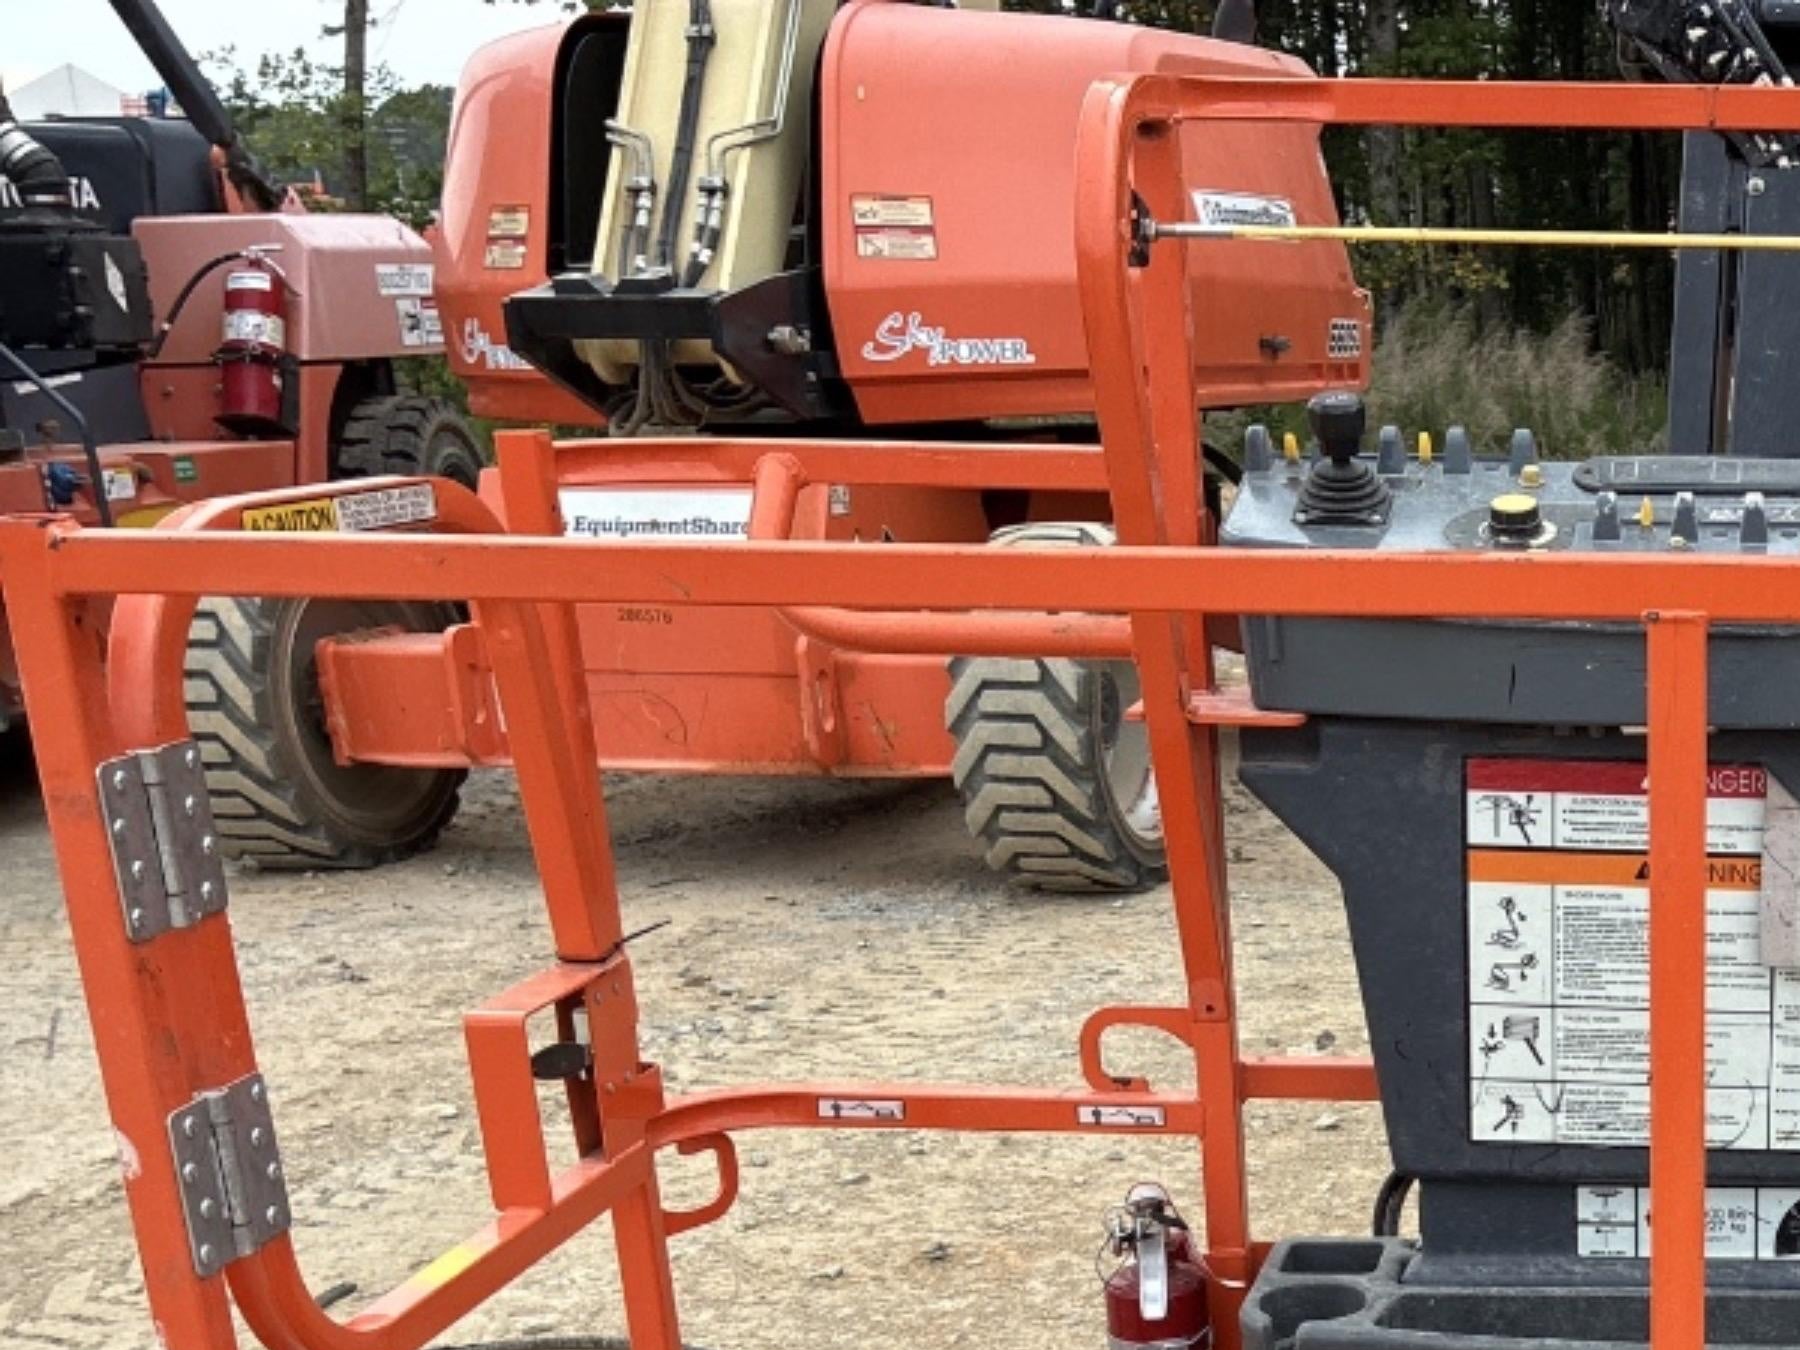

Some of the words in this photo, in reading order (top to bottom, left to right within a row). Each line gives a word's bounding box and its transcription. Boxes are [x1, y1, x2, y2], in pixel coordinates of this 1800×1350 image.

[264, 506, 333, 531] CAUTION
[1705, 769, 1766, 793] NGER
[1708, 862, 1762, 884] NING
